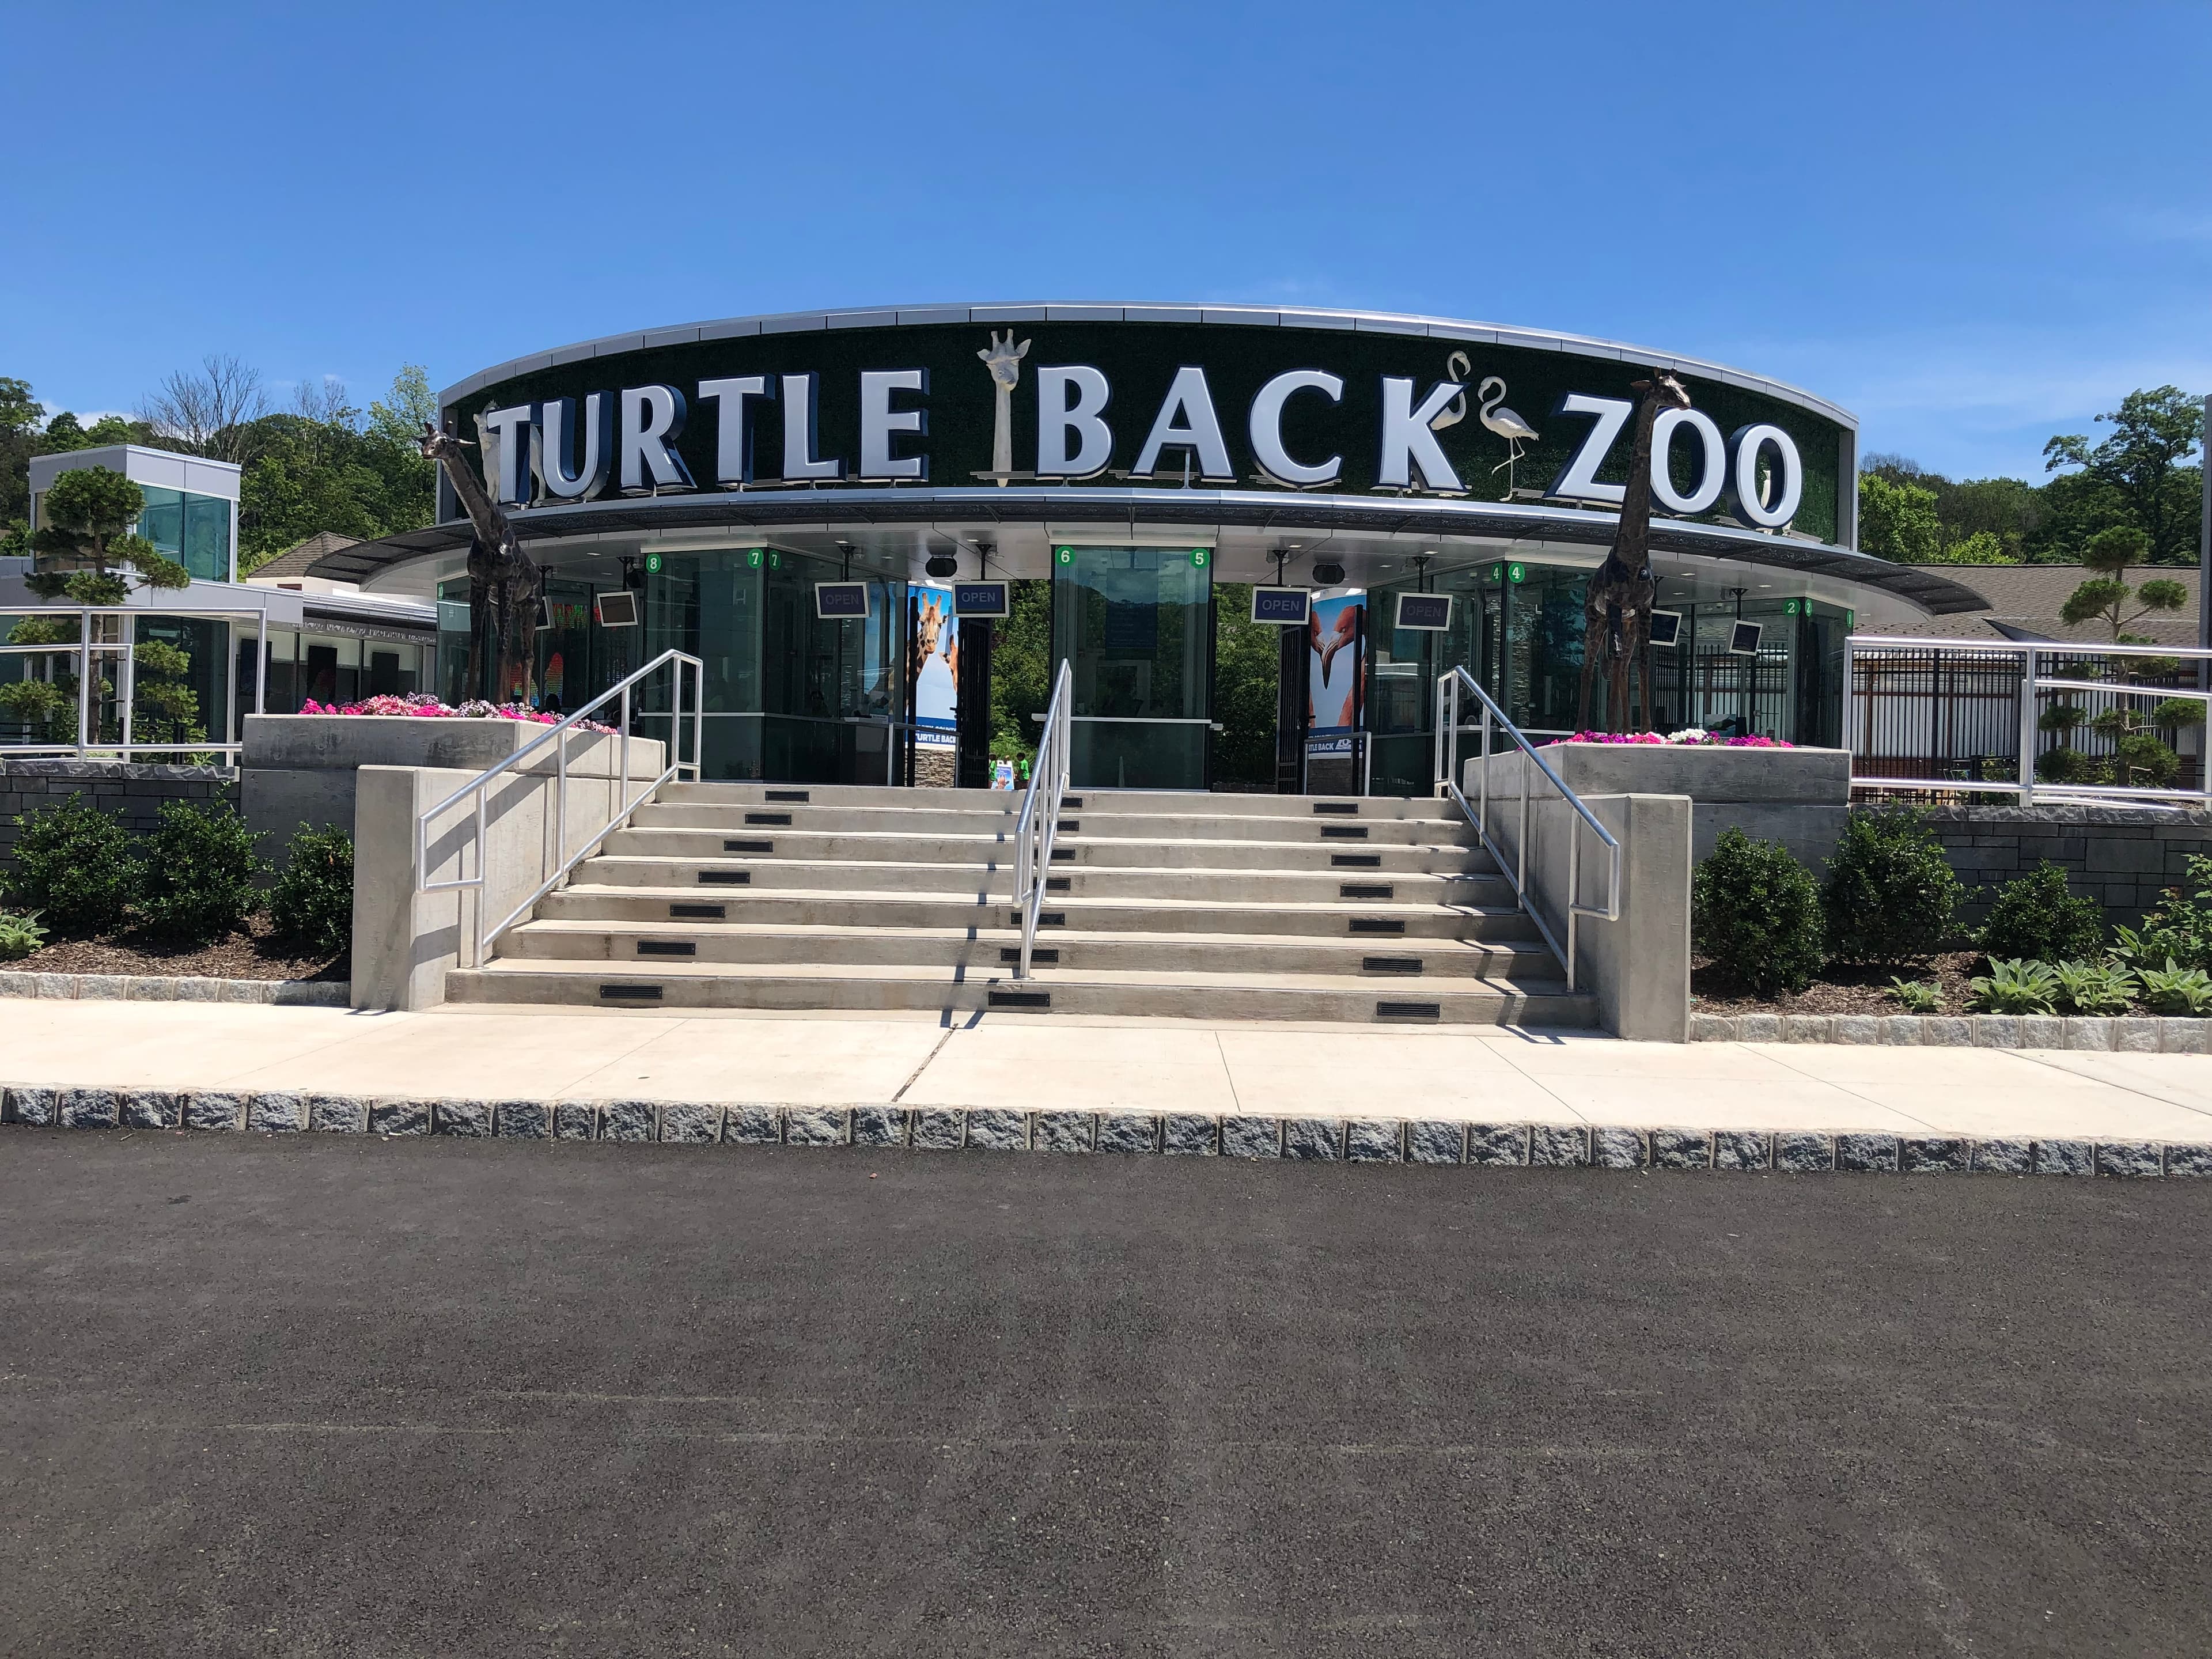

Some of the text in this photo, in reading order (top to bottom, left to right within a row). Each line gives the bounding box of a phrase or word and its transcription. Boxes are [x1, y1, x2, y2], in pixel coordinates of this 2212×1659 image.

[486, 364, 1802, 528] TURTLE BACK ZOO
[752, 552, 759, 565] 7
[771, 554, 778, 566] 7
[1060, 550, 1070, 563] 6
[1195, 552, 1204, 565] 5
[650, 558, 658, 569] 8
[1493, 567, 1499, 579] 4
[1512, 567, 1521, 579] 4
[824, 593, 859, 605] OPEN
[961, 592, 995, 603] OPEN
[1262, 599, 1300, 612] OPEN
[1406, 604, 1442, 618] OPEN
[1787, 602, 1795, 613] 2
[1806, 602, 1810, 613] 2
